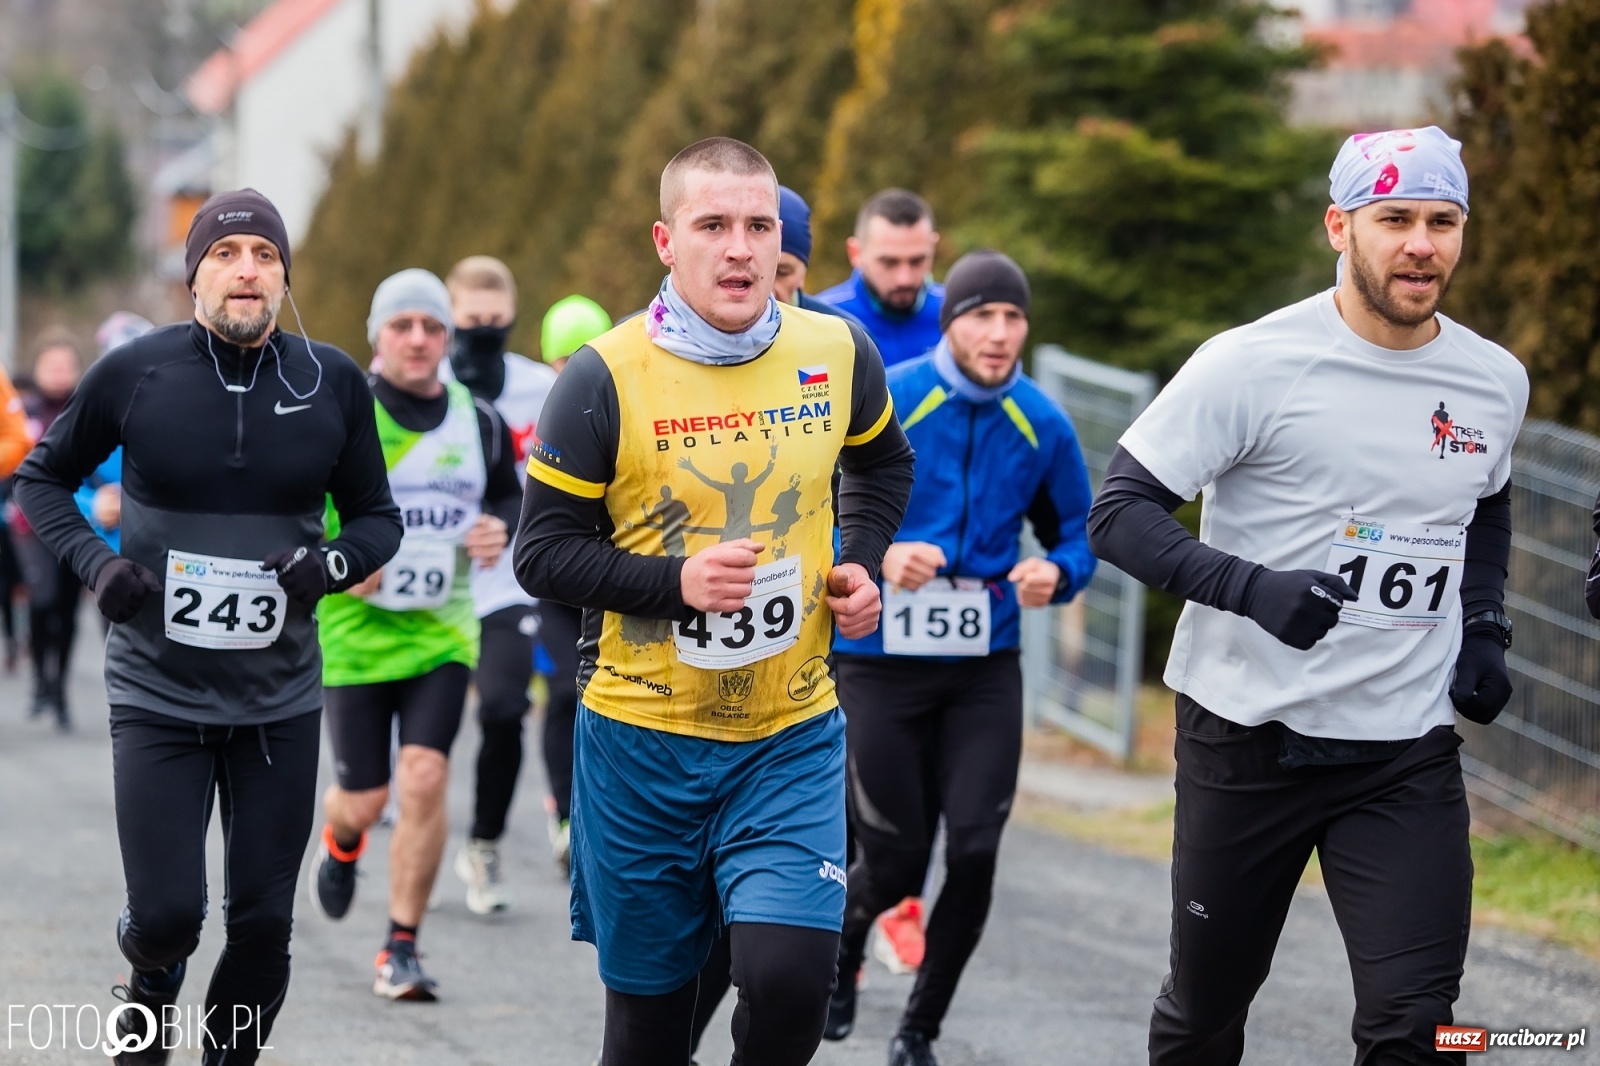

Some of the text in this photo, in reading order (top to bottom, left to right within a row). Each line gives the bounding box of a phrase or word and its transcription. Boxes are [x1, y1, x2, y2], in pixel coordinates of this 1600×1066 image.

[801, 384, 830, 393] CZECH
[802, 391, 830, 400] REPUBLIC
[653, 411, 757, 436] ENERGY
[764, 401, 831, 425] TEAM
[656, 420, 832, 452] BOLATICE
[1450, 440, 1487, 454] STORM
[1389, 532, 1461, 549] www.personalbest.pl
[1338, 555, 1450, 612] 161
[171, 587, 278, 633] 243
[678, 595, 795, 650] 439
[894, 606, 981, 639] 158
[711, 711, 750, 719] BOLATICE
